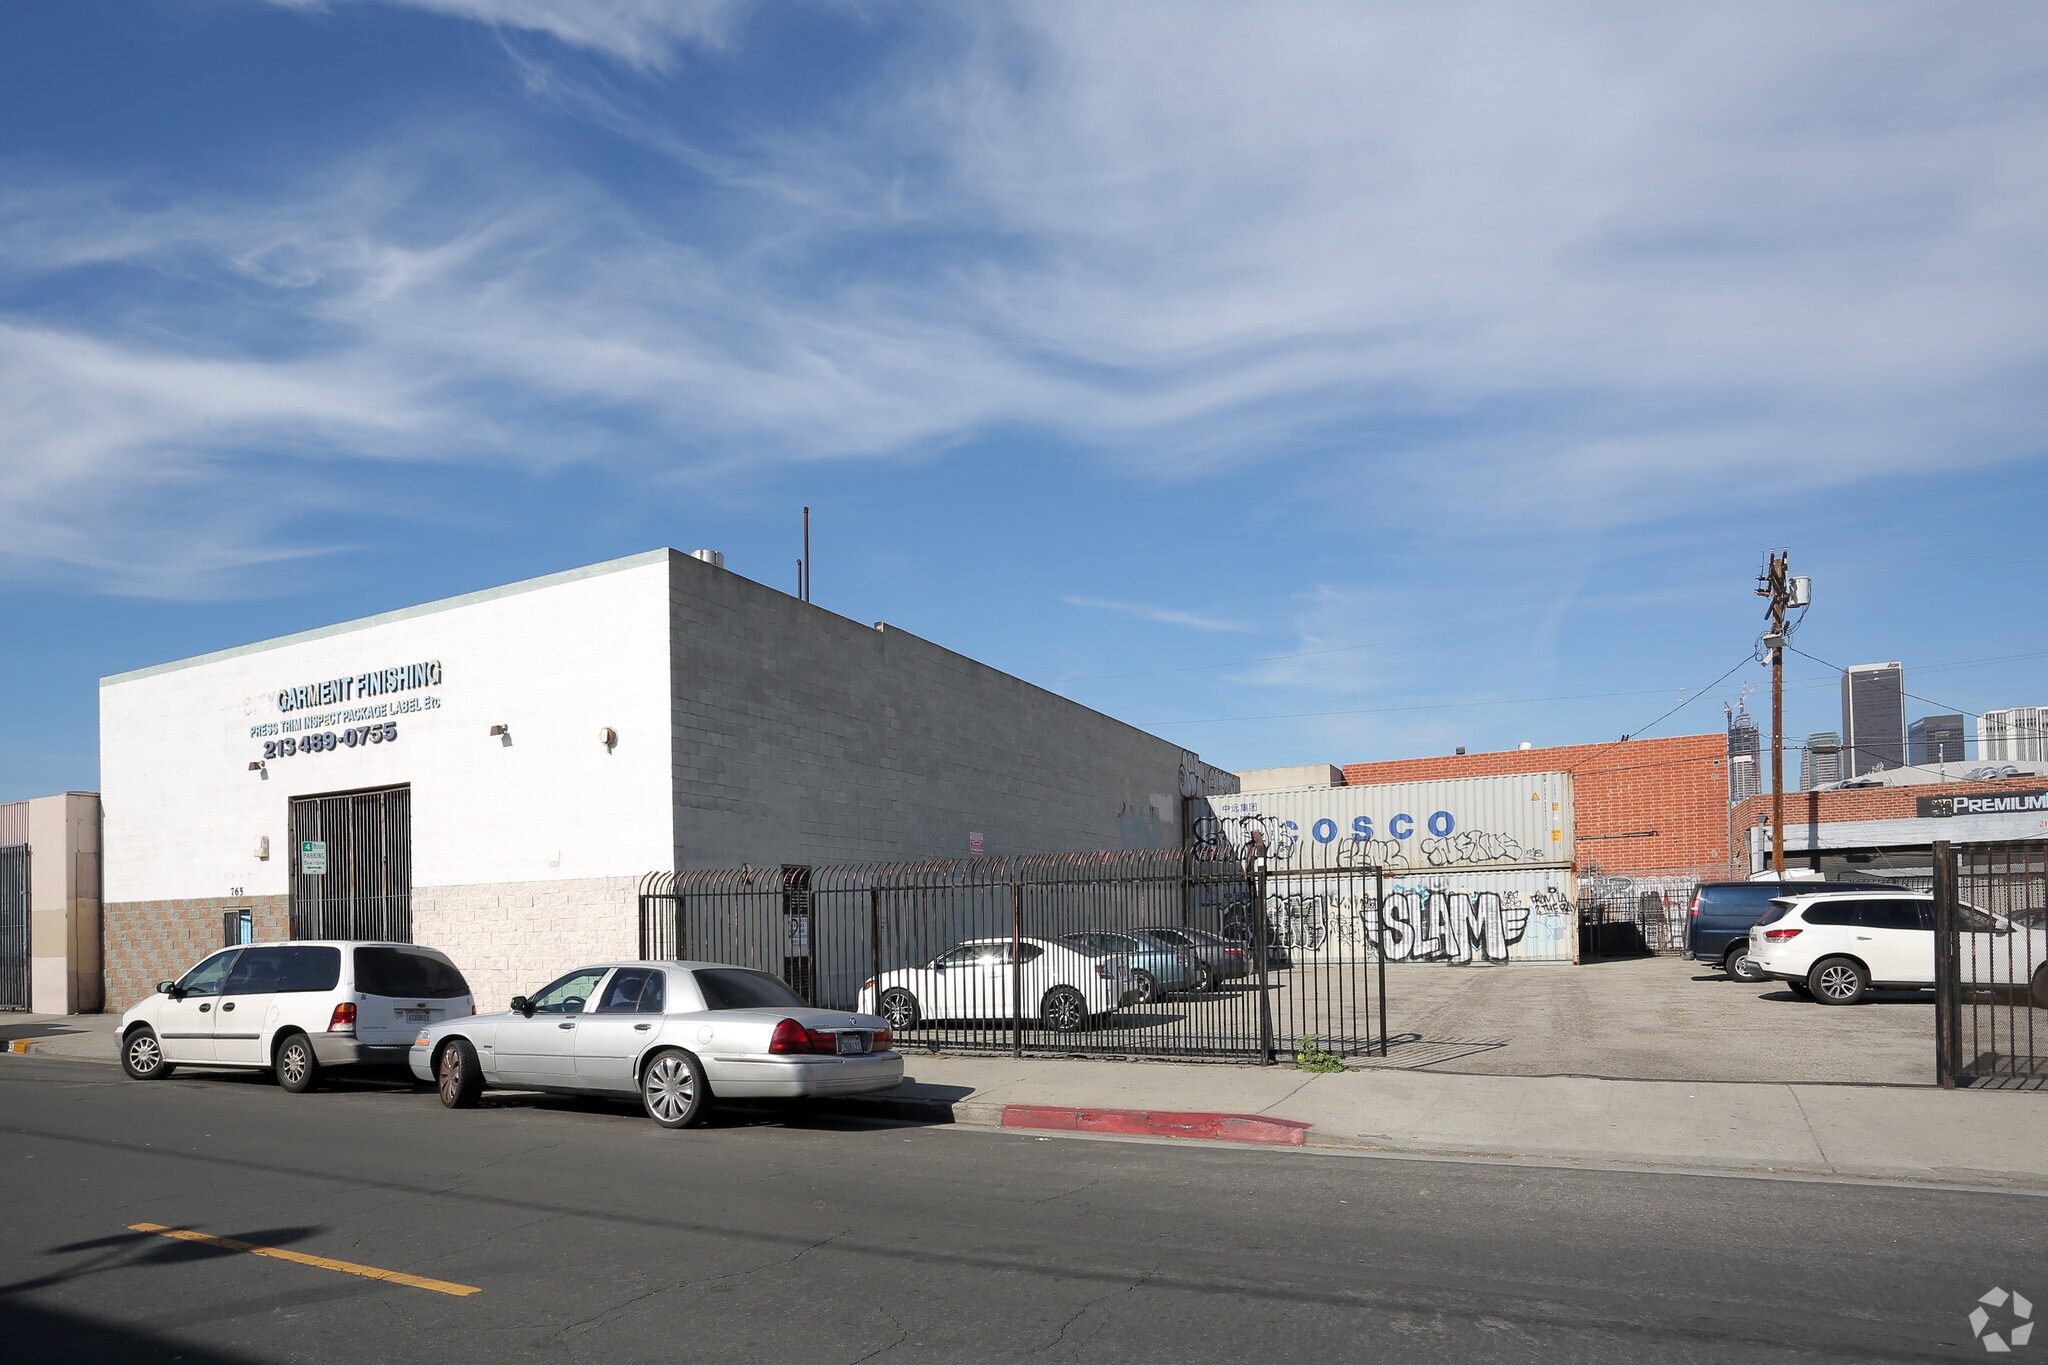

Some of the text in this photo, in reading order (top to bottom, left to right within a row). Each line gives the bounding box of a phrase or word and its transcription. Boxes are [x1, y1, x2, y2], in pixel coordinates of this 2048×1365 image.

[277, 677, 353, 713] GARMENT
[355, 659, 442, 699] FINISHING
[250, 721, 279, 738] PRESS
[280, 718, 301, 733] TRIM
[304, 711, 341, 730] INSPECT
[343, 703, 388, 723] PACKAGE
[389, 698, 422, 716] LABEL
[263, 721, 398, 759] 213 489-0755
[1222, 803, 1258, 813] 中远集团
[1953, 797, 2046, 814] PREMIUM
[230, 887, 244, 896] 765
[1382, 890, 1509, 966] SLAM
